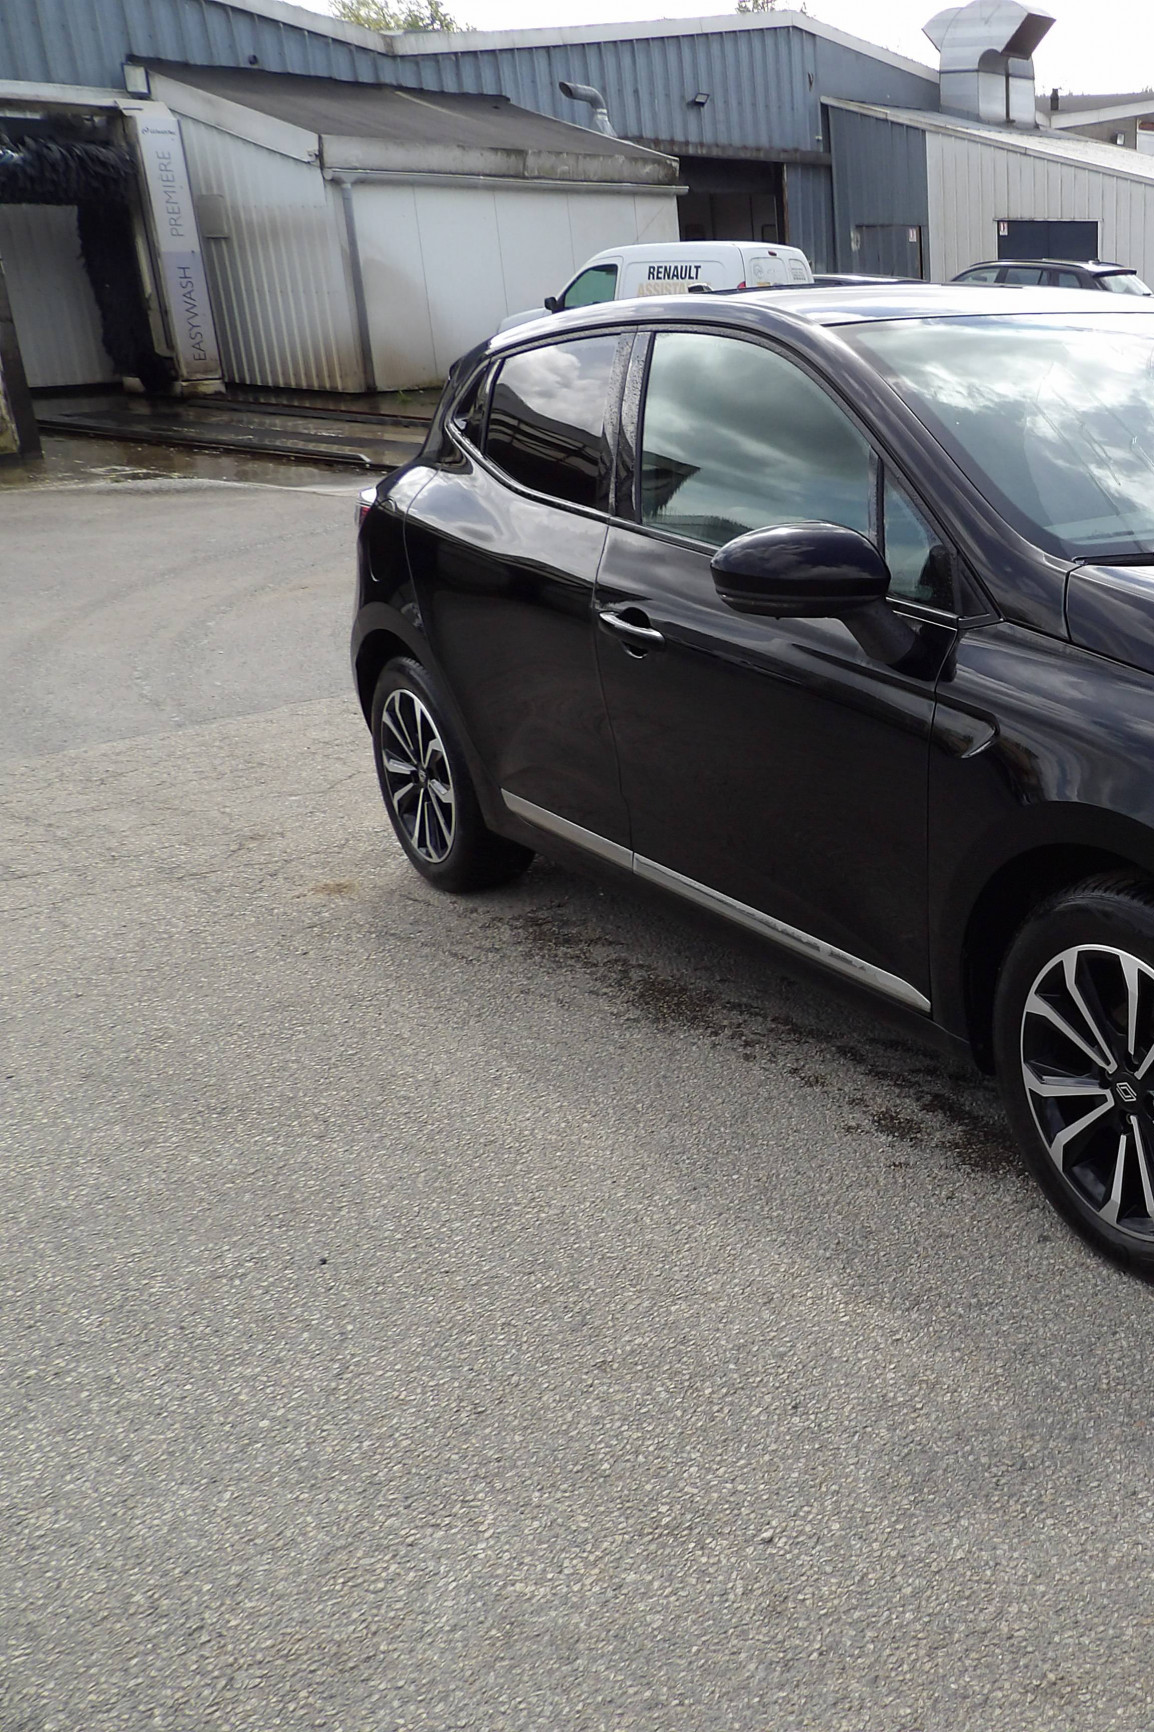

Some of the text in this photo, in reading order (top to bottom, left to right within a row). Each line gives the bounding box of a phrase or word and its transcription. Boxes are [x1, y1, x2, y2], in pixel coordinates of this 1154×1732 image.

[156, 150, 185, 237] PREMIÈRE
[637, 281, 703, 296] ASSISTA
[647, 265, 702, 280] RENAULT
[177, 266, 207, 361] EASYWASH
